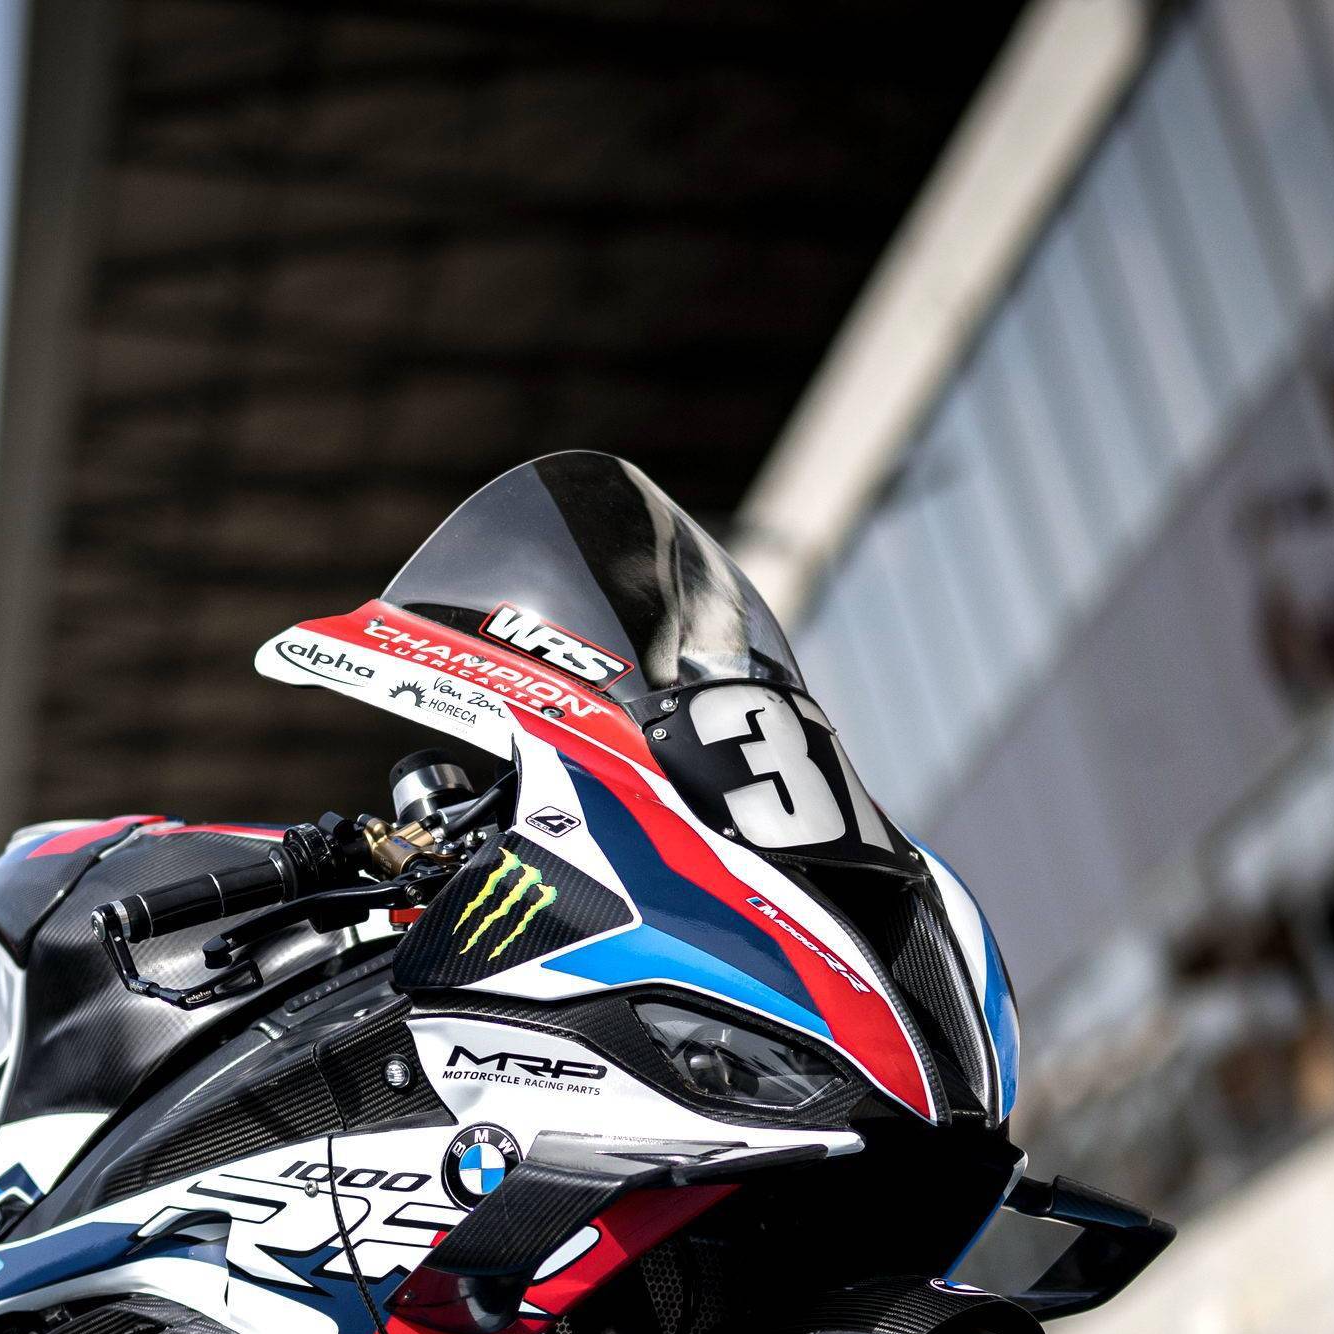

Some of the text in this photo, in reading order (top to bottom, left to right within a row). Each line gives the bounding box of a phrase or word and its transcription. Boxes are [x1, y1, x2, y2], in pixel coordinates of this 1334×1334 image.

[486, 607, 625, 680] WRS
[287, 644, 375, 679] alpha
[363, 625, 594, 718] CHAMPION
[378, 642, 543, 709] LUBRICANTS
[433, 676, 463, 701] Van
[428, 698, 478, 726] HORECA
[446, 1045, 608, 1080] MRP
[442, 1070, 601, 1096] MOTORCYCLE RACING PARTS
[451, 1128, 516, 1158] BMW
[279, 1160, 433, 1192] 1000
